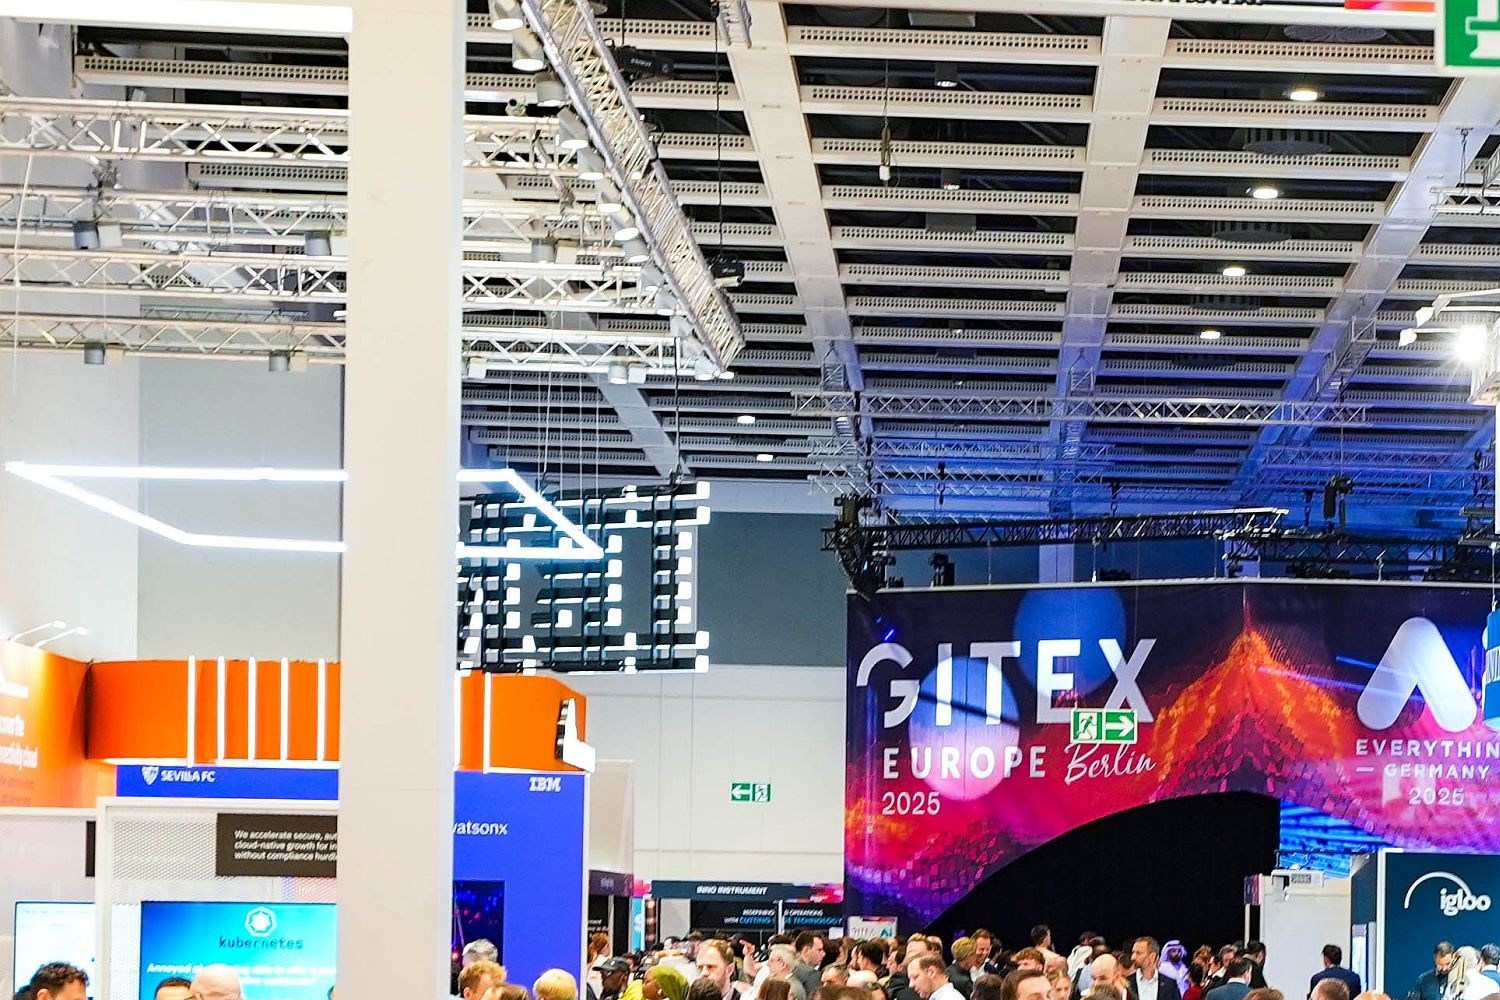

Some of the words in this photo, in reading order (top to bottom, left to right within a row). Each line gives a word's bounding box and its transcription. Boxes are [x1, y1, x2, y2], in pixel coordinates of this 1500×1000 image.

[856, 638, 1157, 728] GITEX
[882, 745, 1047, 780] EUROPE
[1064, 741, 1157, 785] Berlin
[1383, 763, 1491, 779] GERMANY
[161, 770, 200, 783] SEVILLA
[200, 770, 216, 783] FC
[529, 776, 562, 792] IBM
[881, 791, 941, 816] 2025
[1408, 787, 1465, 805] 2025
[234, 829, 248, 839] We
[249, 830, 293, 840] accelerate
[234, 851, 266, 860] without
[1440, 888, 1492, 917] igloo
[219, 935, 304, 950] kubernetes
[147, 963, 192, 976] Annoyed
